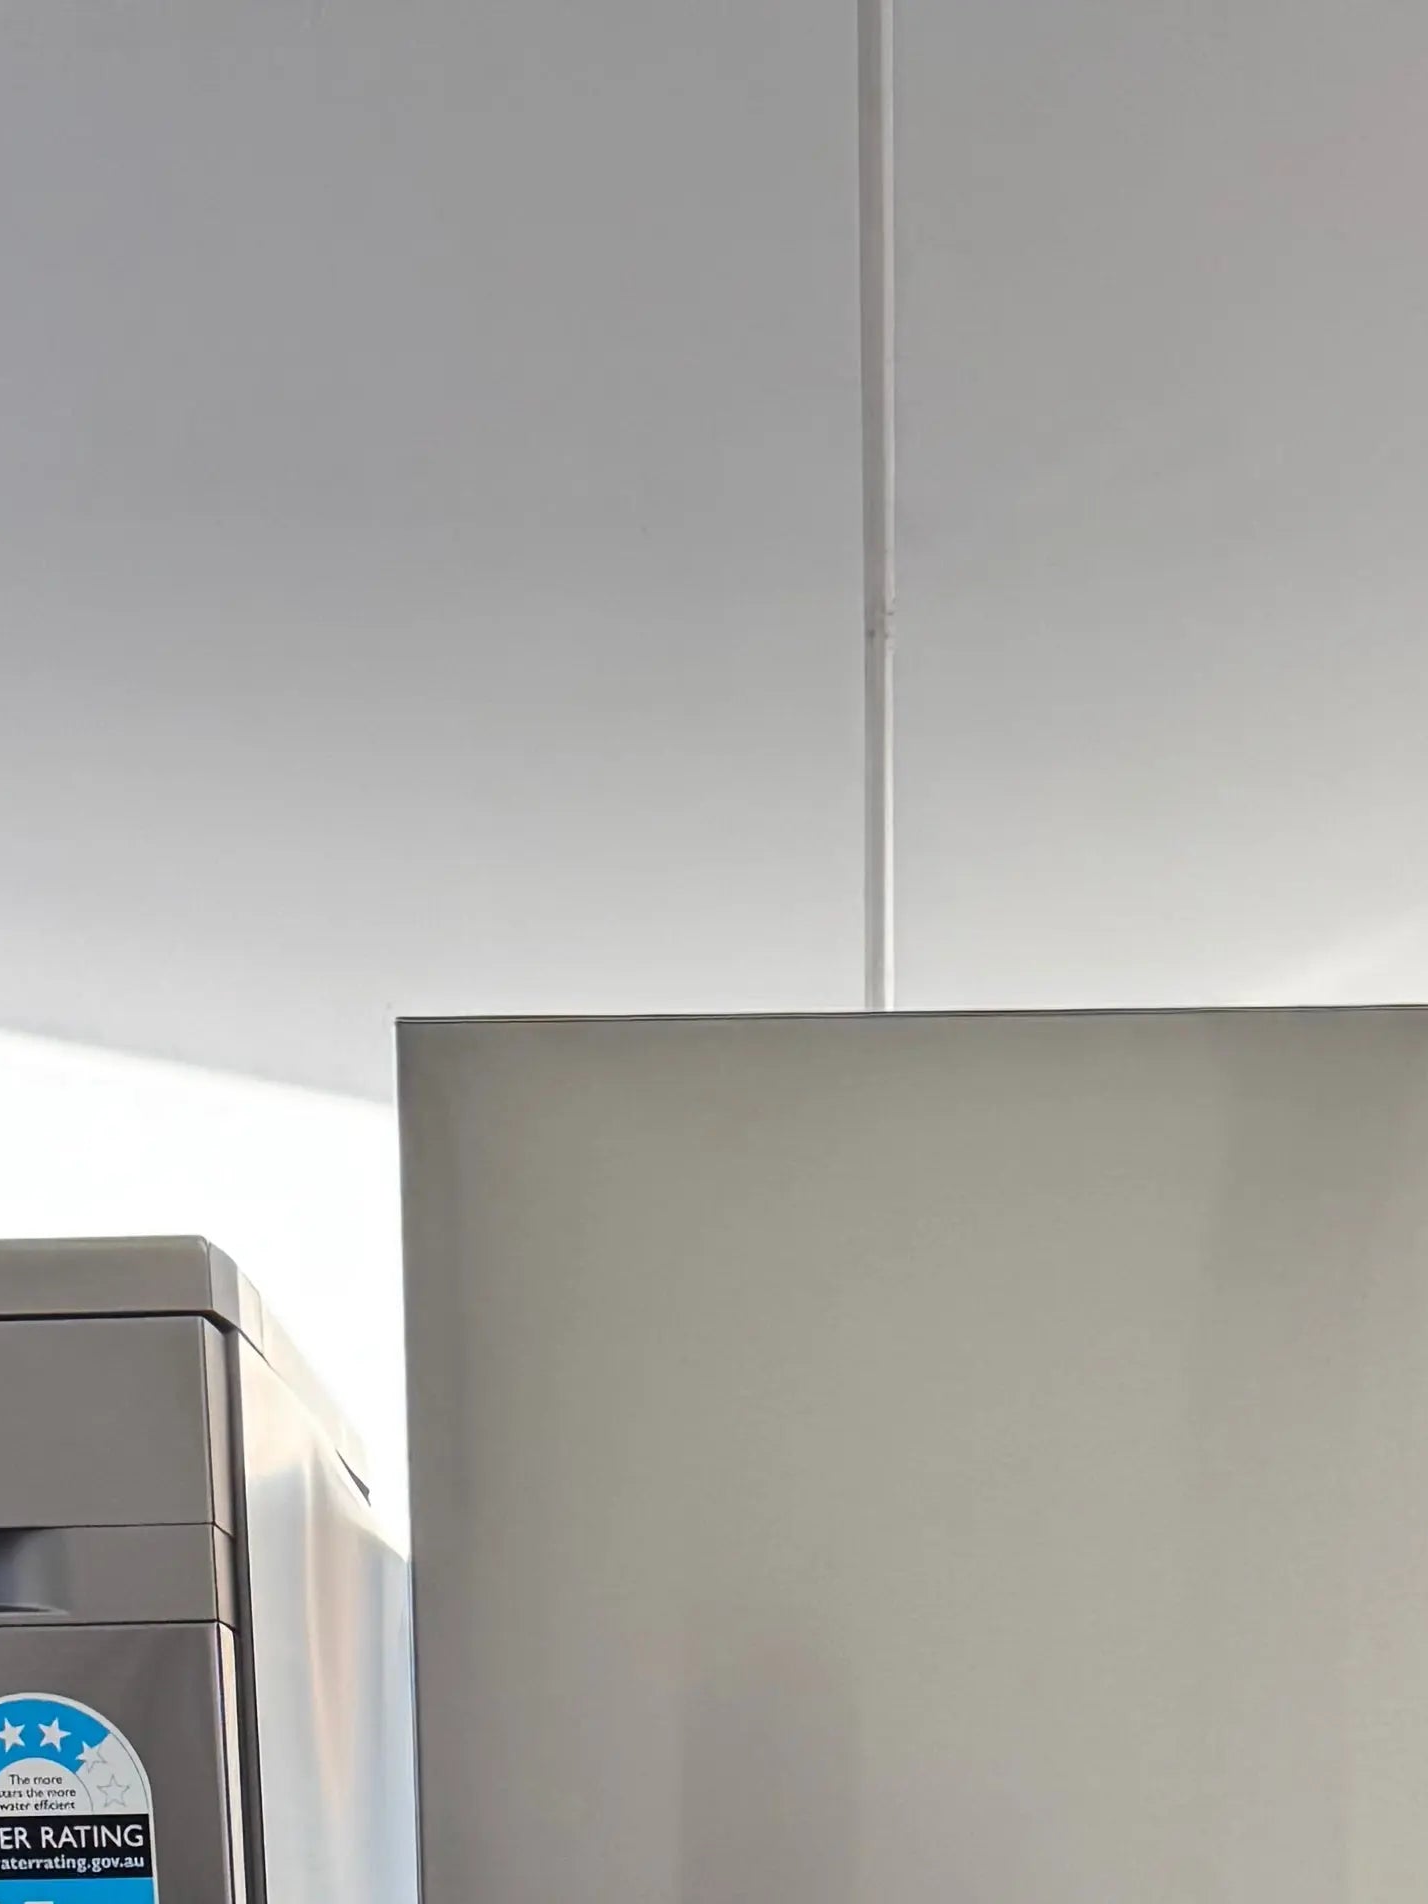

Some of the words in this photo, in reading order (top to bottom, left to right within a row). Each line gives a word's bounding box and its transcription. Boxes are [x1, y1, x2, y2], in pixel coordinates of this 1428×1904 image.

[9, 1774, 31, 1785] The
[33, 1776, 63, 1785] more
[26, 1788, 44, 1798] the
[46, 1788, 77, 1798] more
[0, 1801, 30, 1811] water
[34, 1800, 76, 1810] efficient
[40, 1824, 144, 1850] RATING
